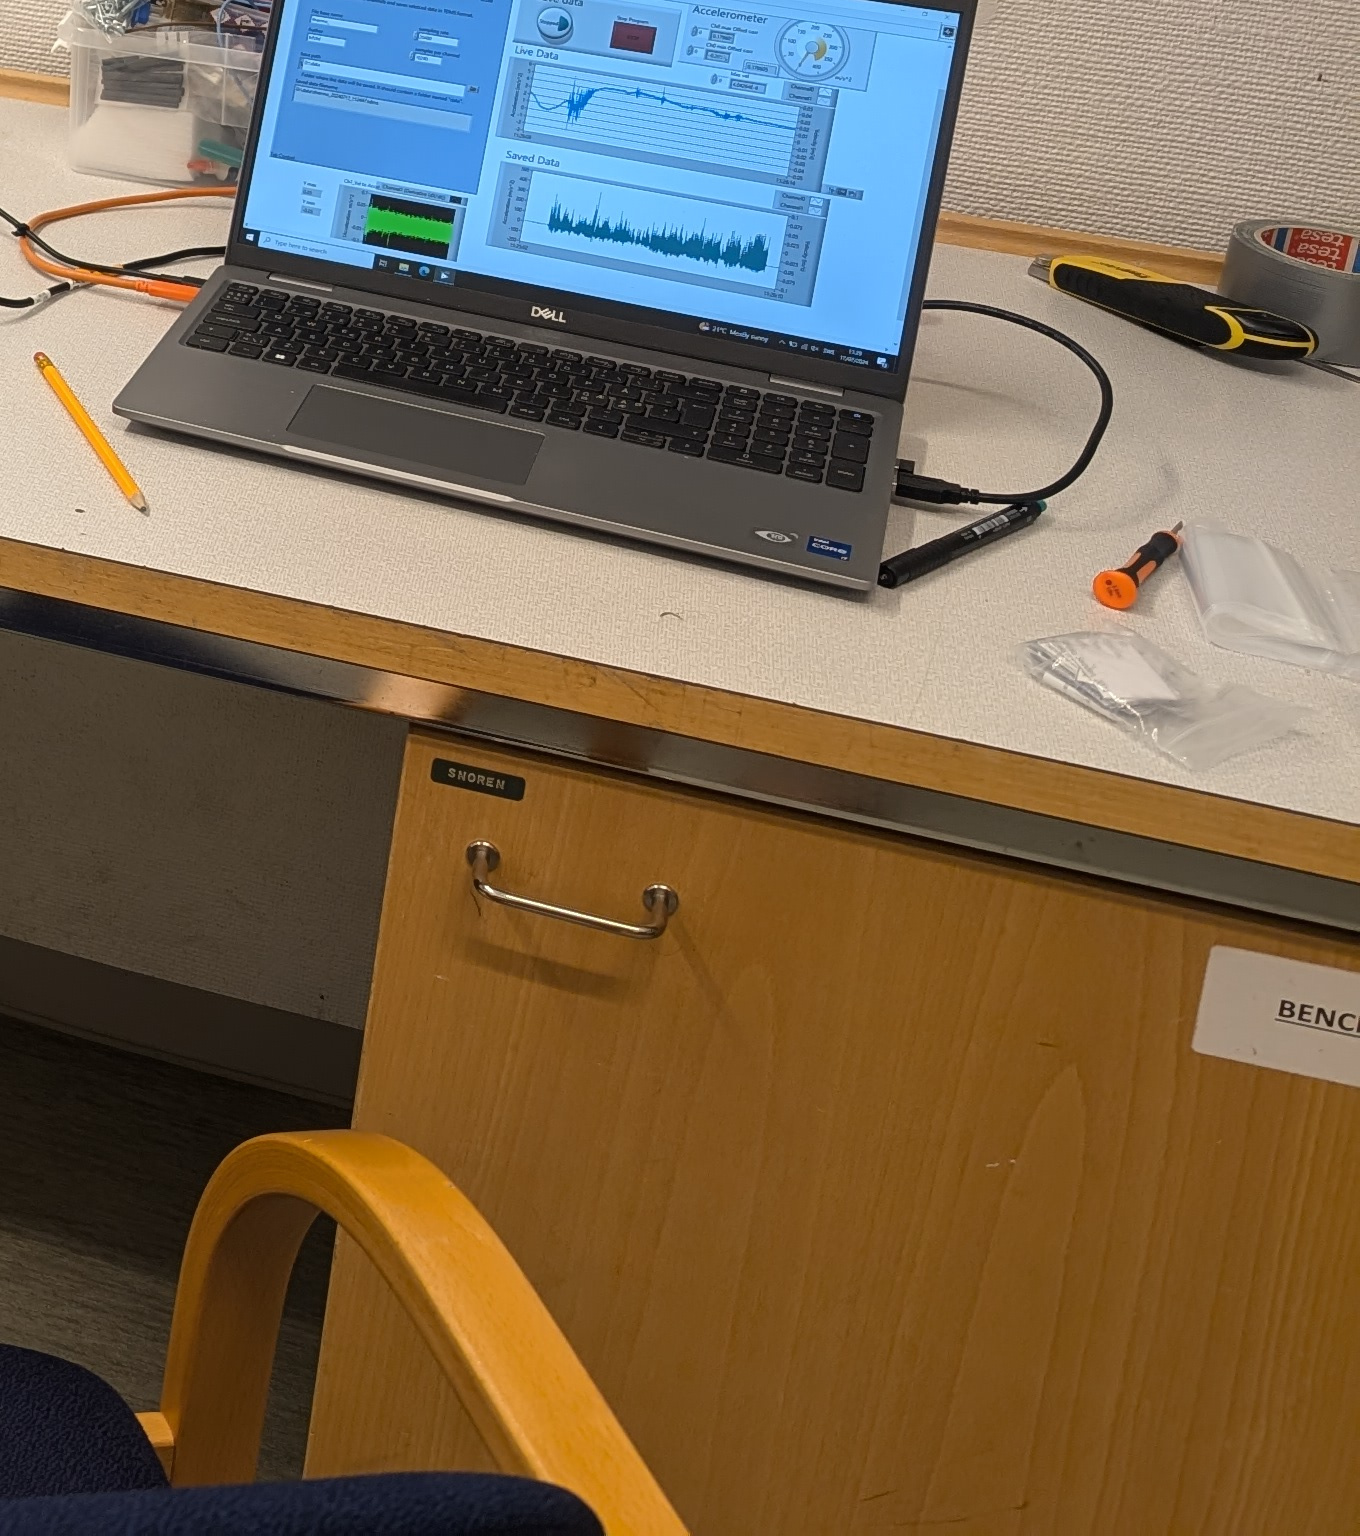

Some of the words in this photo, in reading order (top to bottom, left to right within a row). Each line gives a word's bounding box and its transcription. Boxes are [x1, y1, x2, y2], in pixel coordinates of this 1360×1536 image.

[692, 5, 768, 24] Accelerometer
[514, 45, 533, 56] Live
[536, 48, 559, 60] Data
[505, 150, 535, 162] Saved
[537, 155, 560, 167] Data
[1300, 229, 1345, 247] tesa
[308, 246, 327, 254] search
[1296, 243, 1341, 260] tesa
[531, 306, 567, 324] DELL
[730, 329, 750, 340] Mostly
[1278, 1000, 1360, 1033] BENC
